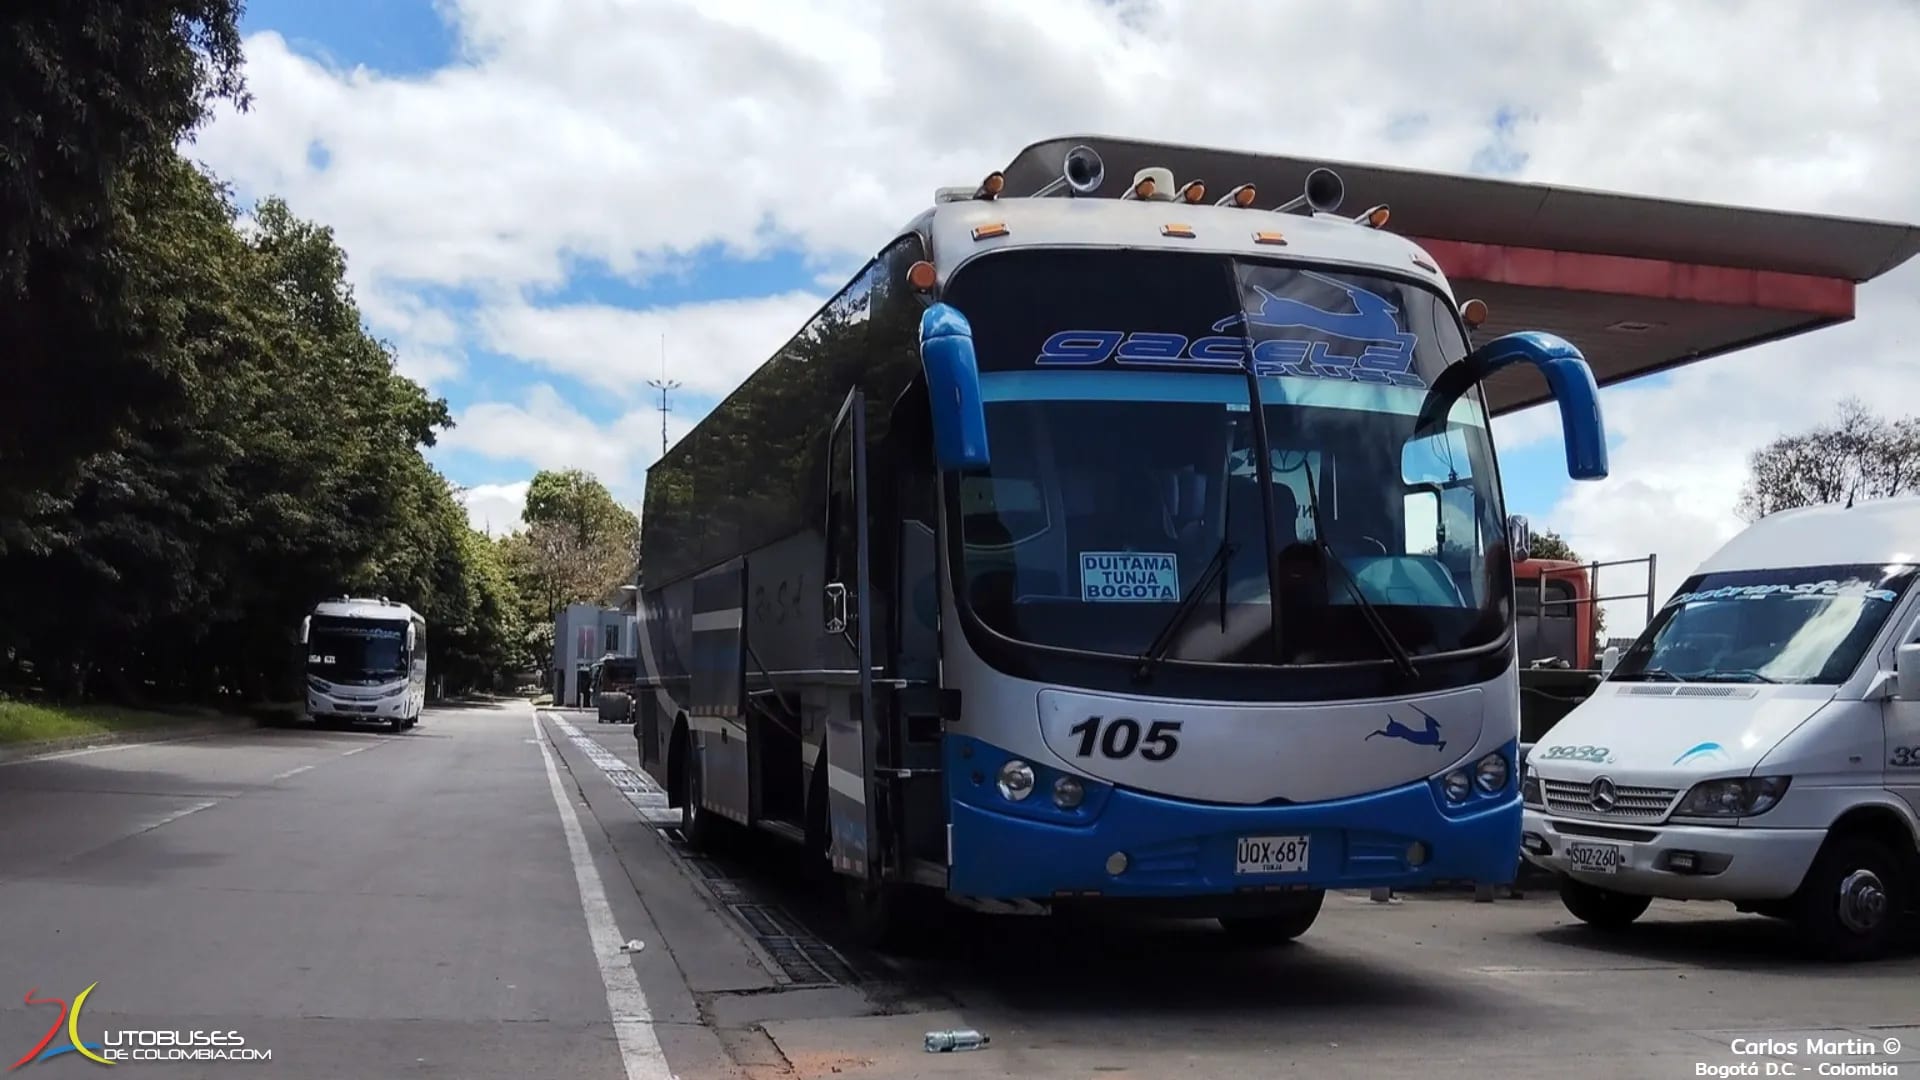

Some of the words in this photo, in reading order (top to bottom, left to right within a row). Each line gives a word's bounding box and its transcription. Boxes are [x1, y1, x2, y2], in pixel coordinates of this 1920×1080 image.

[1085, 557, 1172, 571] DUITAMA
[1102, 571, 1158, 584] TUNJA
[1087, 585, 1174, 598] BOGOTA
[1070, 716, 1184, 762] 105
